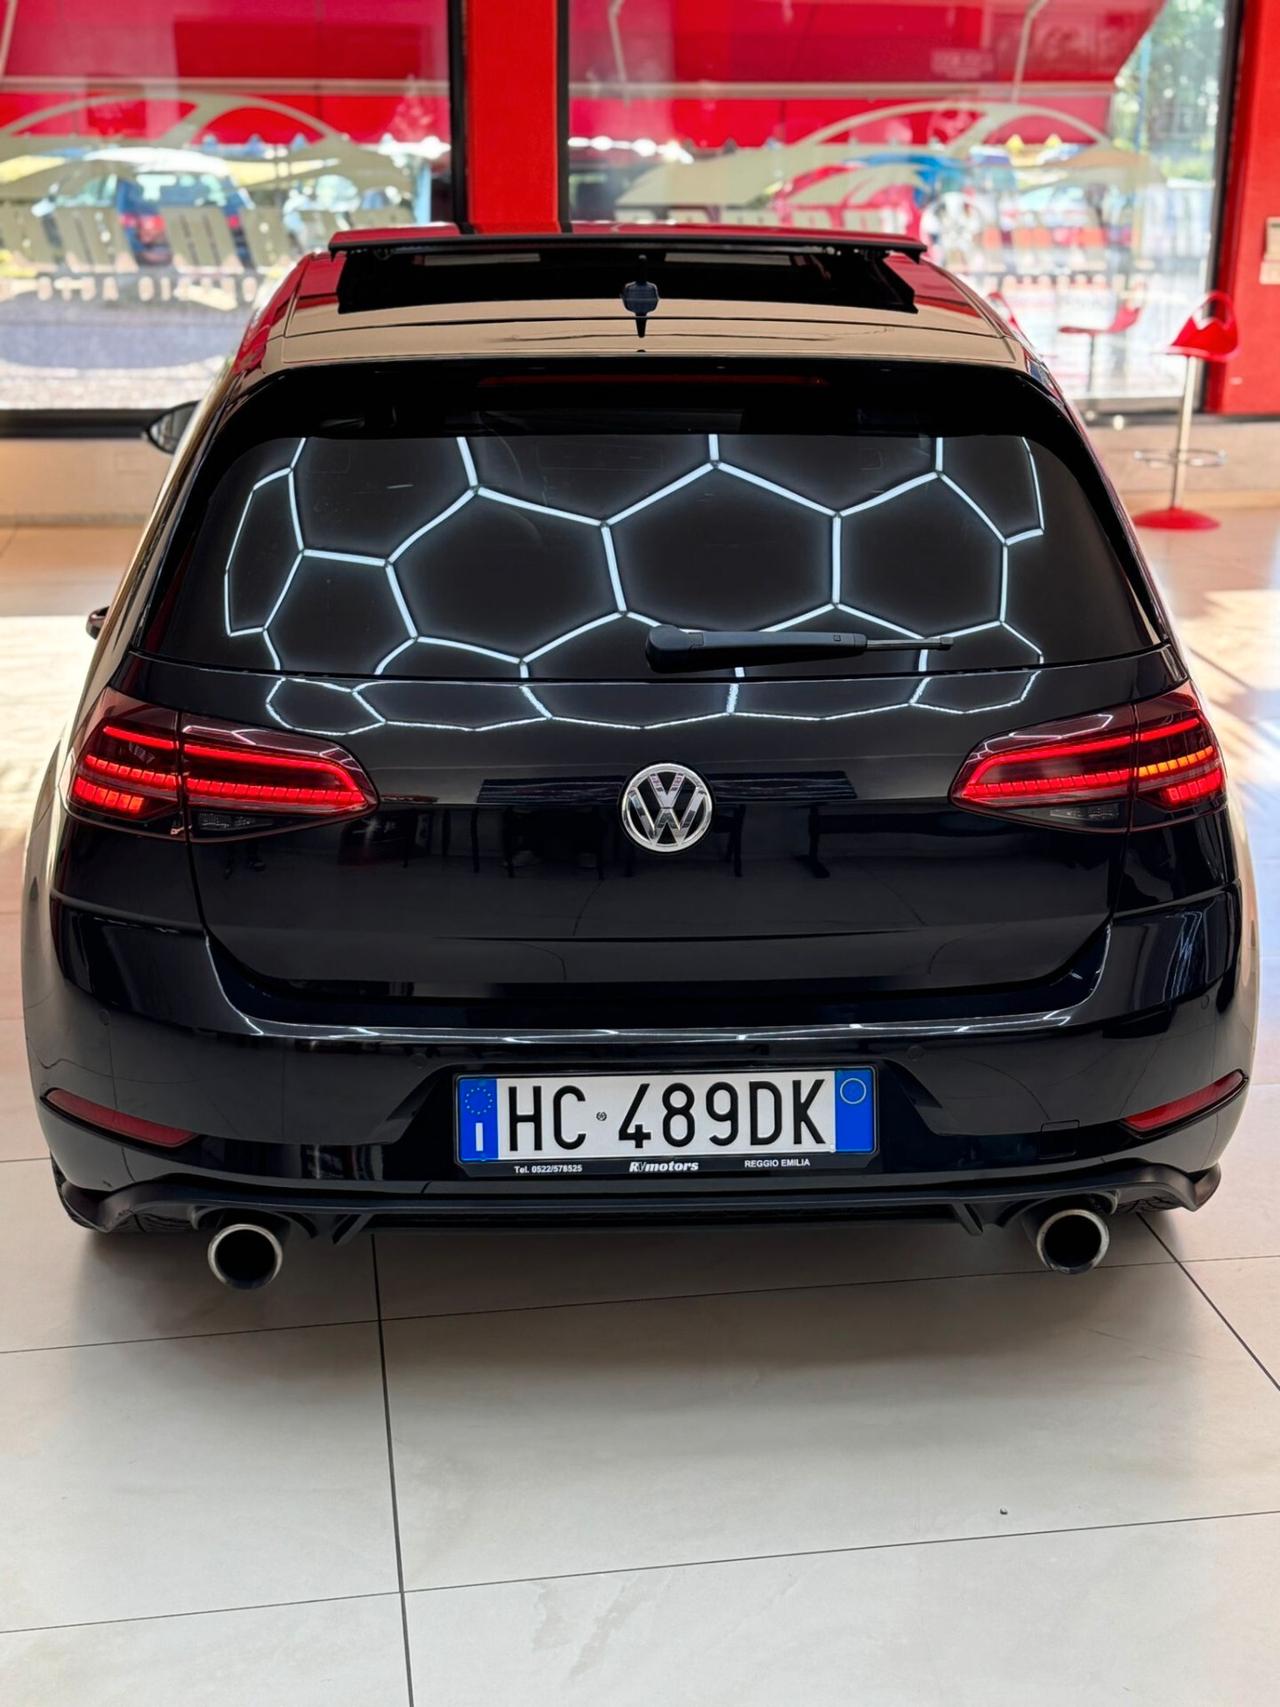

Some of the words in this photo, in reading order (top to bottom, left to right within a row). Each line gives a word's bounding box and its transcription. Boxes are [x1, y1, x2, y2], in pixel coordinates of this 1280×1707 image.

[622, 763, 712, 852] VW
[508, 1085, 586, 1151] HC
[618, 1079, 825, 1149] 489DK
[475, 1122, 483, 1152] I
[514, 1165, 529, 1174] Tel.
[744, 1159, 779, 1168] REGGIO
[780, 1158, 811, 1167] EMILIA
